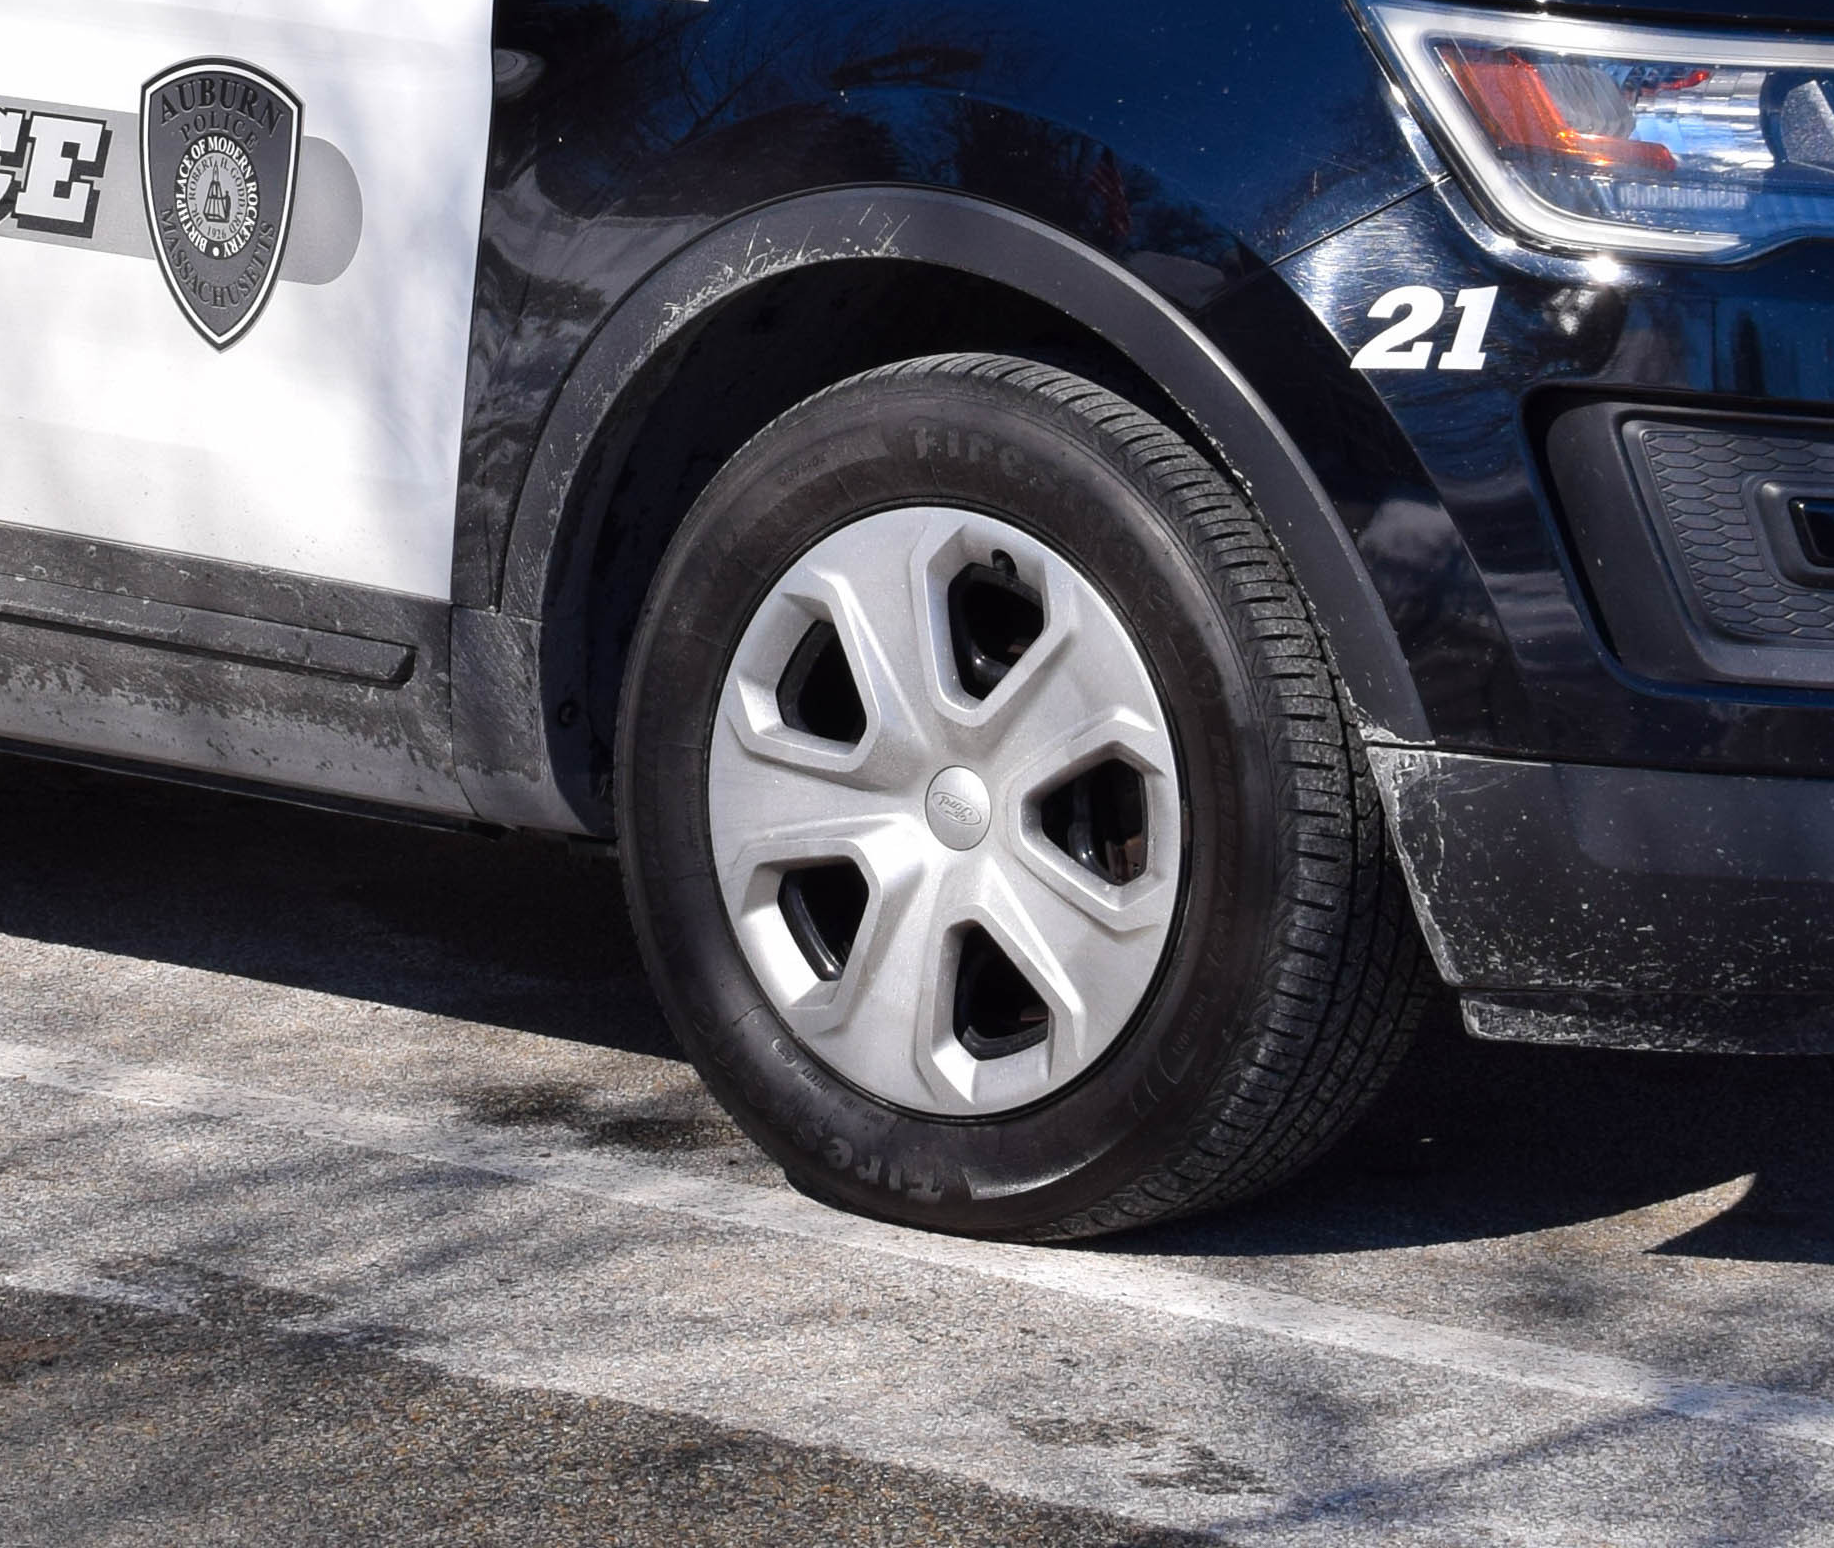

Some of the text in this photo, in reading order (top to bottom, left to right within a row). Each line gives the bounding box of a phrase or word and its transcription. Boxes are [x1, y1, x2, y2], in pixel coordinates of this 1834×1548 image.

[160, 78, 284, 137] AUBURN
[180, 111, 258, 153] POLICE
[175, 136, 258, 257] BIRTHPLACE OF MODERN ROCKETRY
[161, 206, 275, 308] MASSACHUSETTS
[1349, 285, 1499, 370] 21
